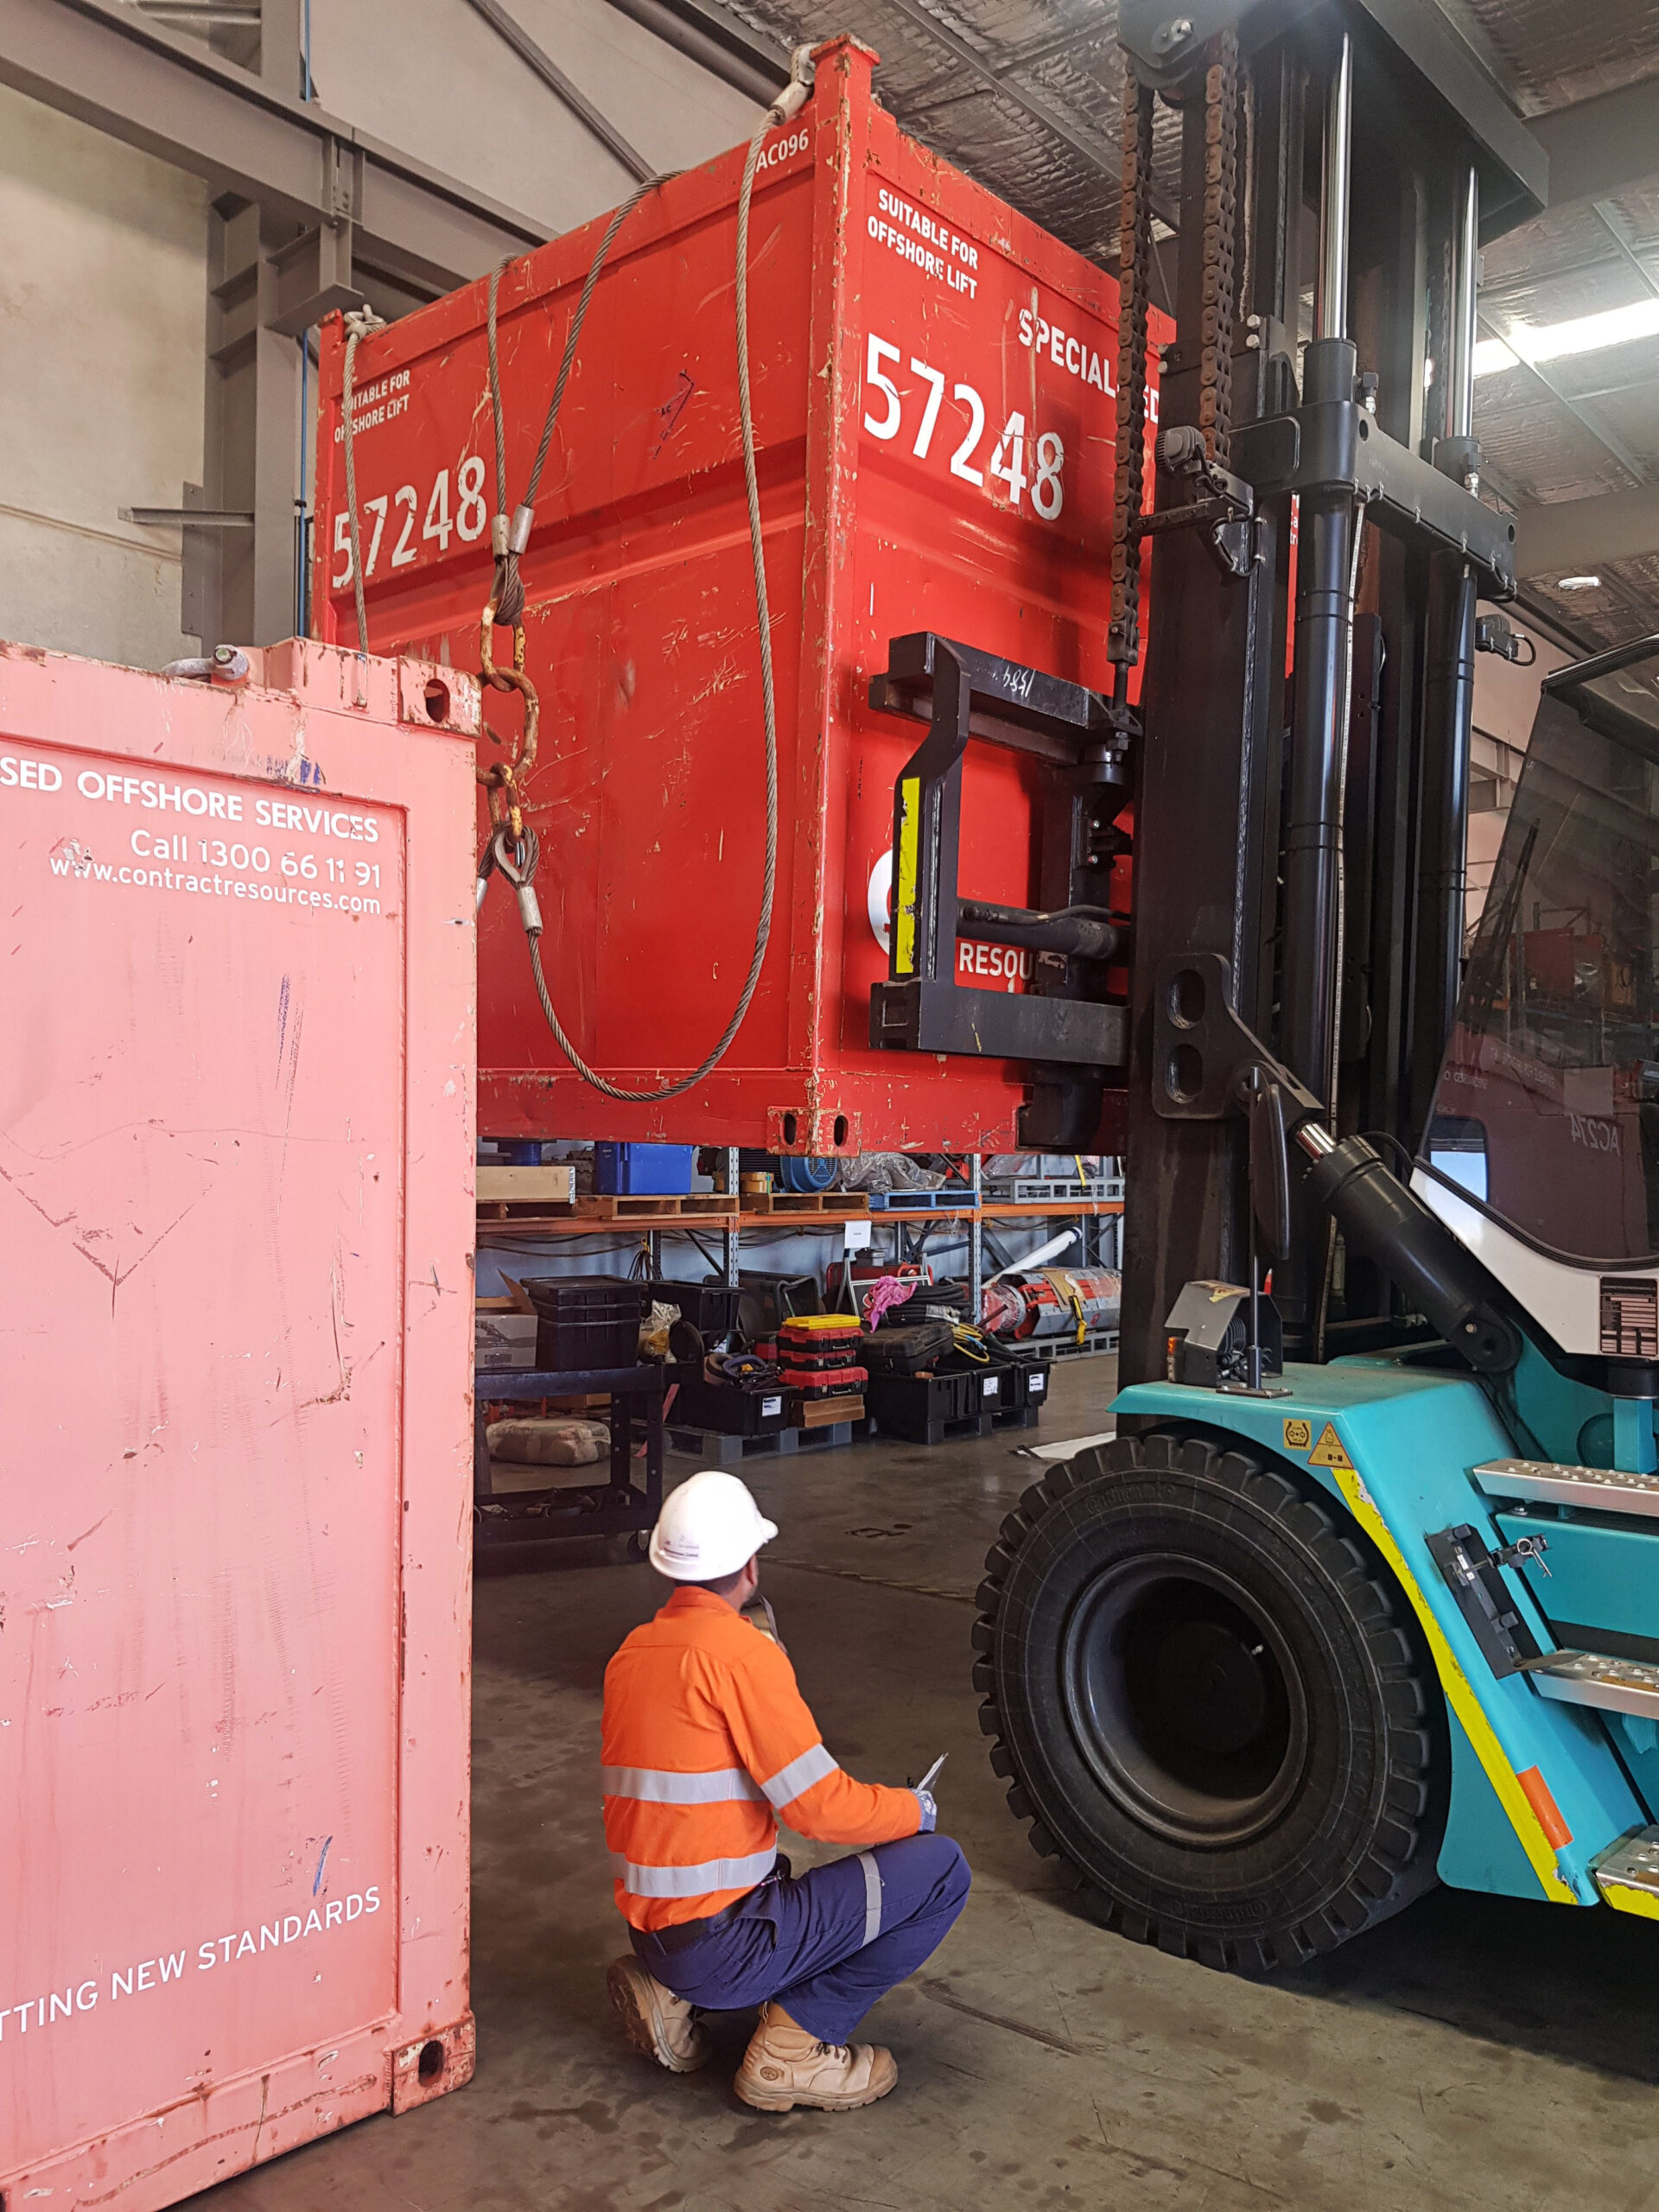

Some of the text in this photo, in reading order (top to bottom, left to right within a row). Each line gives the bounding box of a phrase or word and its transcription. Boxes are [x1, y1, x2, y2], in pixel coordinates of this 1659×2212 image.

[755, 128, 809, 173] AC096
[867, 215, 978, 299] OFFSHORE LIFT
[878, 188, 978, 270] SUITABLE FOR
[334, 394, 410, 443] OFSHORE LIFT
[390, 370, 410, 393] FOR
[863, 332, 1065, 522] 57248
[332, 455, 487, 589] 57248
[0, 756, 379, 843] SED OFFSHORE SERVICES
[49, 856, 381, 915] www.contractresources.com
[130, 829, 380, 889] Call 1300 66 11 91
[0, 1886, 381, 2043] TTING NEW STANDARDS
